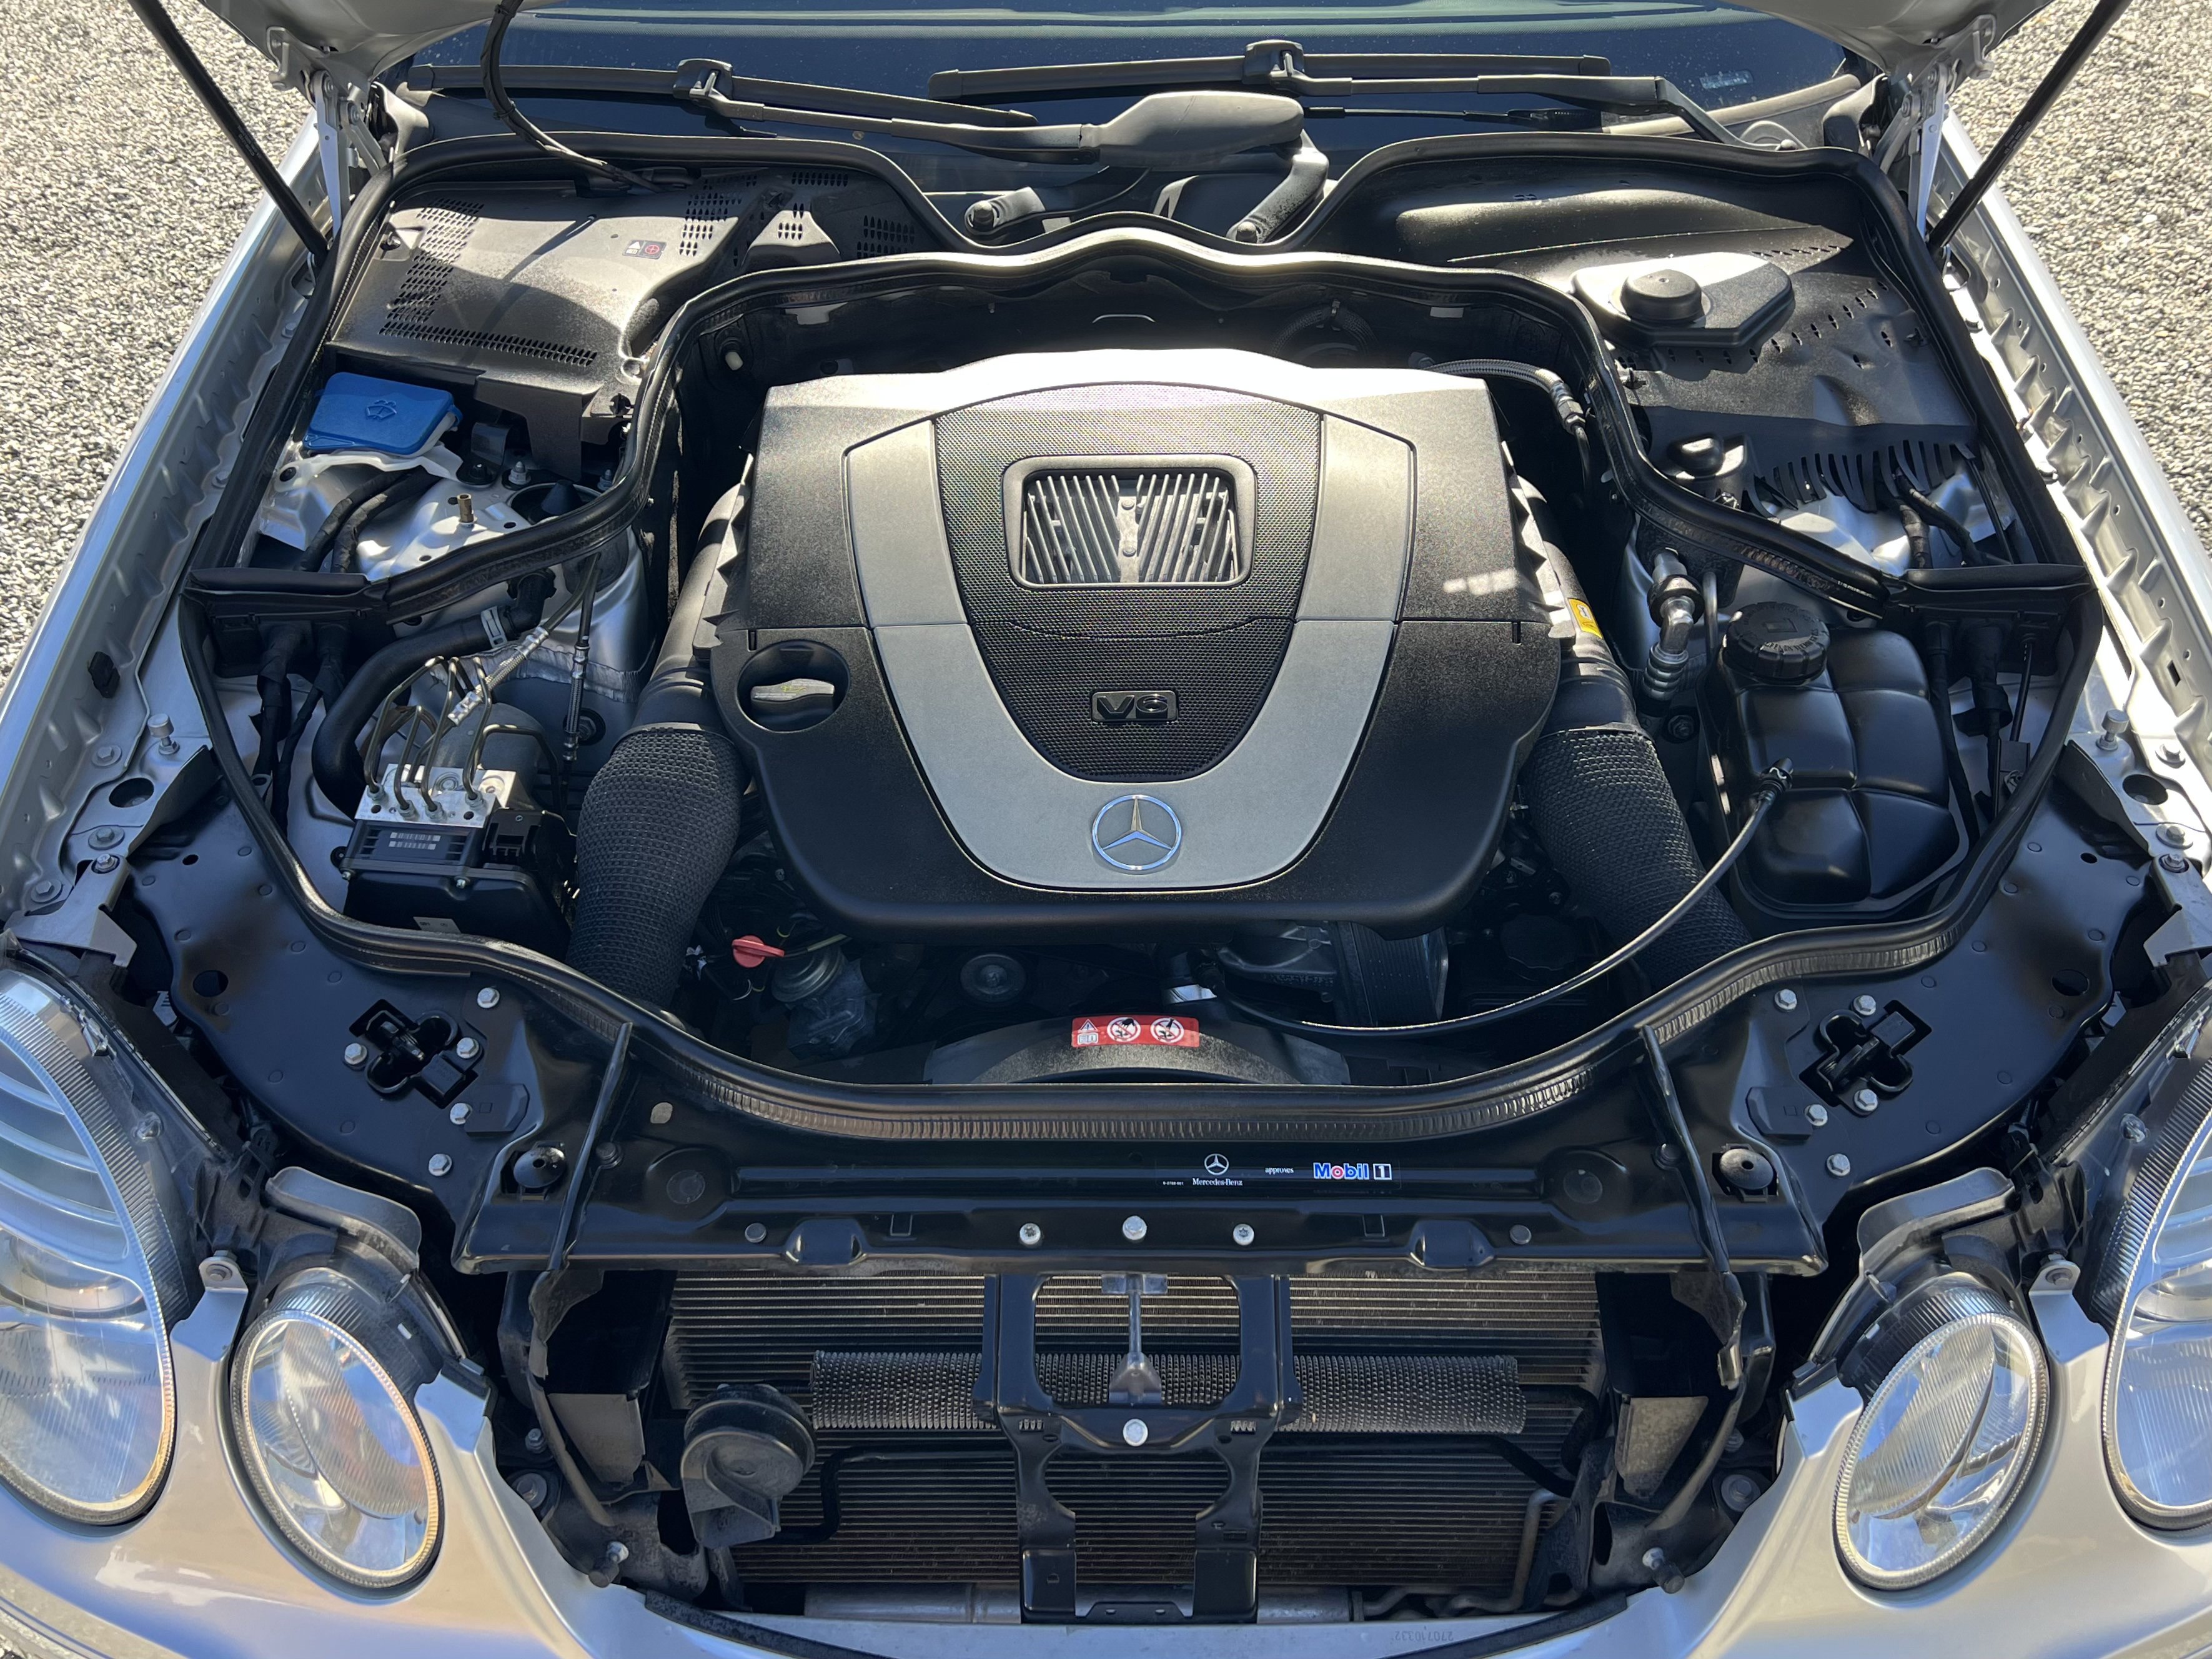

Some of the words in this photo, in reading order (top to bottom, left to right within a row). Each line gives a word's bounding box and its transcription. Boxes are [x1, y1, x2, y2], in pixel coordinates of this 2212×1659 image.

[1096, 694, 1168, 719] V6
[1192, 1177, 1243, 1187] Mercedes-Benz
[1264, 1166, 1294, 1175] approves
[1312, 1162, 1369, 1180] Mobil
